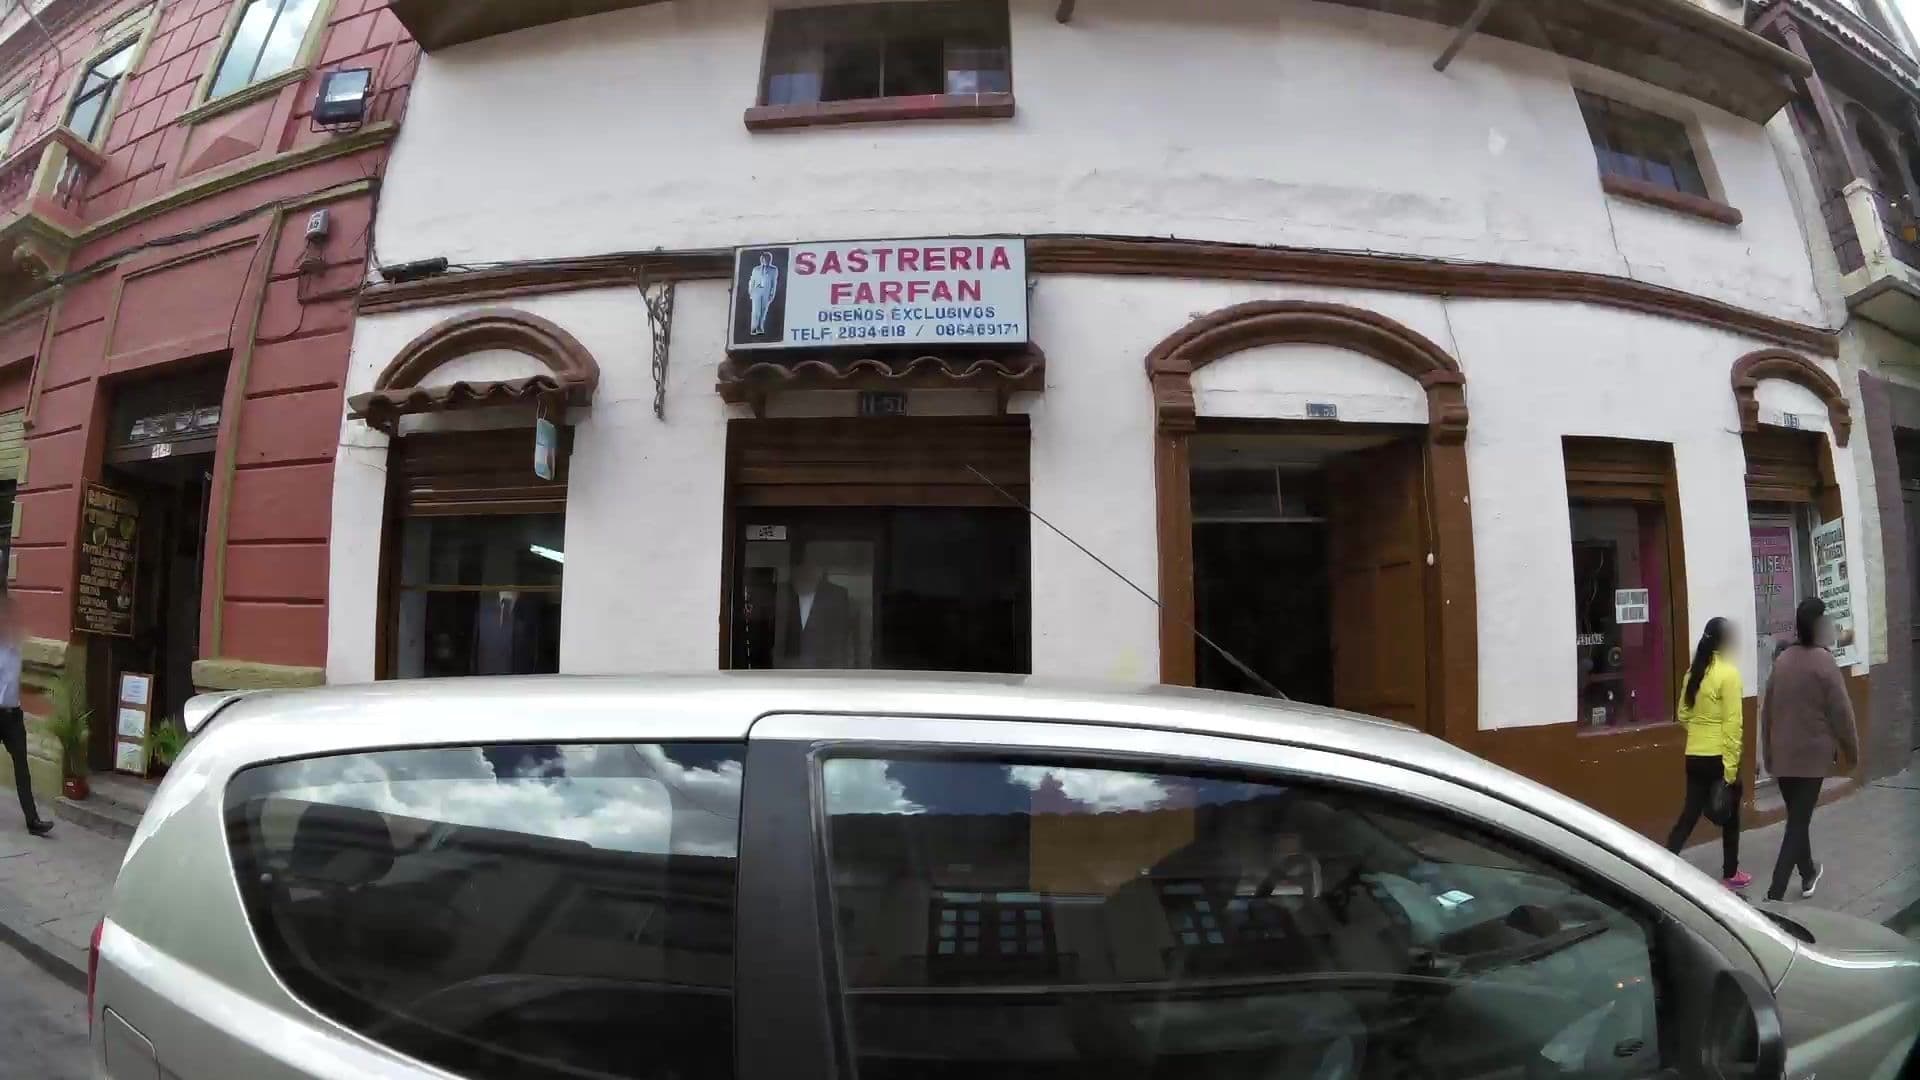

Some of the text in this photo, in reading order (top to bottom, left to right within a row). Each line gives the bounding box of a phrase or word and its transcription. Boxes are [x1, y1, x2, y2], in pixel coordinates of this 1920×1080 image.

[795, 246, 1012, 276] SASTRERIA
[830, 279, 982, 305] FARFAN
[818, 305, 995, 323] DISEÑOS EXCLUSIVOS
